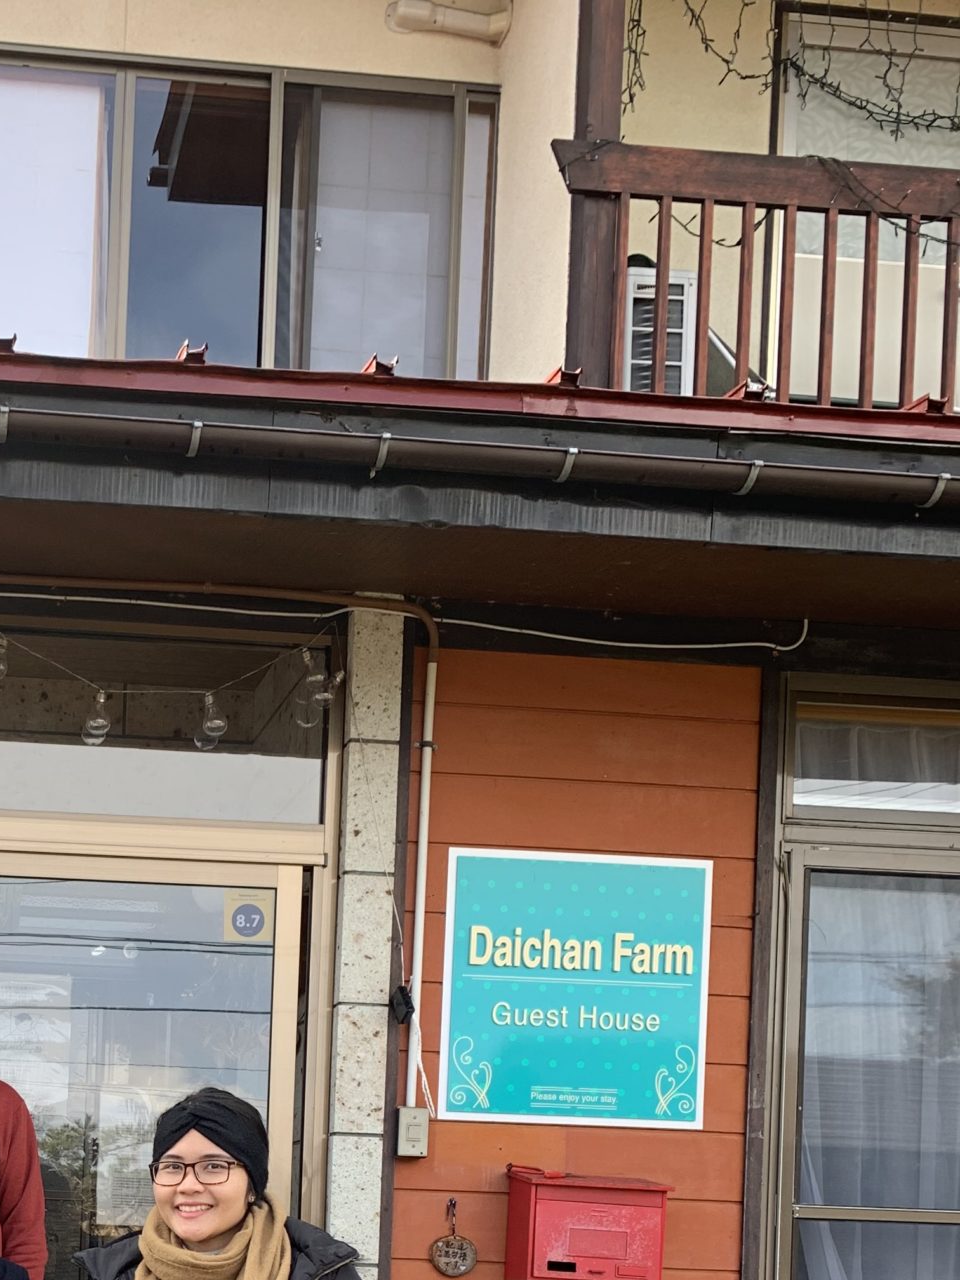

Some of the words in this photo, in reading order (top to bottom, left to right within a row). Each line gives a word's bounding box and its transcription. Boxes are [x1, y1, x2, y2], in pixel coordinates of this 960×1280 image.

[236, 914, 260, 927] 8.7
[468, 925, 602, 971] Daichan
[613, 932, 694, 975] Farm
[492, 1001, 569, 1028] Guest
[579, 1005, 660, 1032] House
[530, 1091, 557, 1101] Please
[559, 1094, 580, 1103] enjoy
[581, 1095, 599, 1103] your
